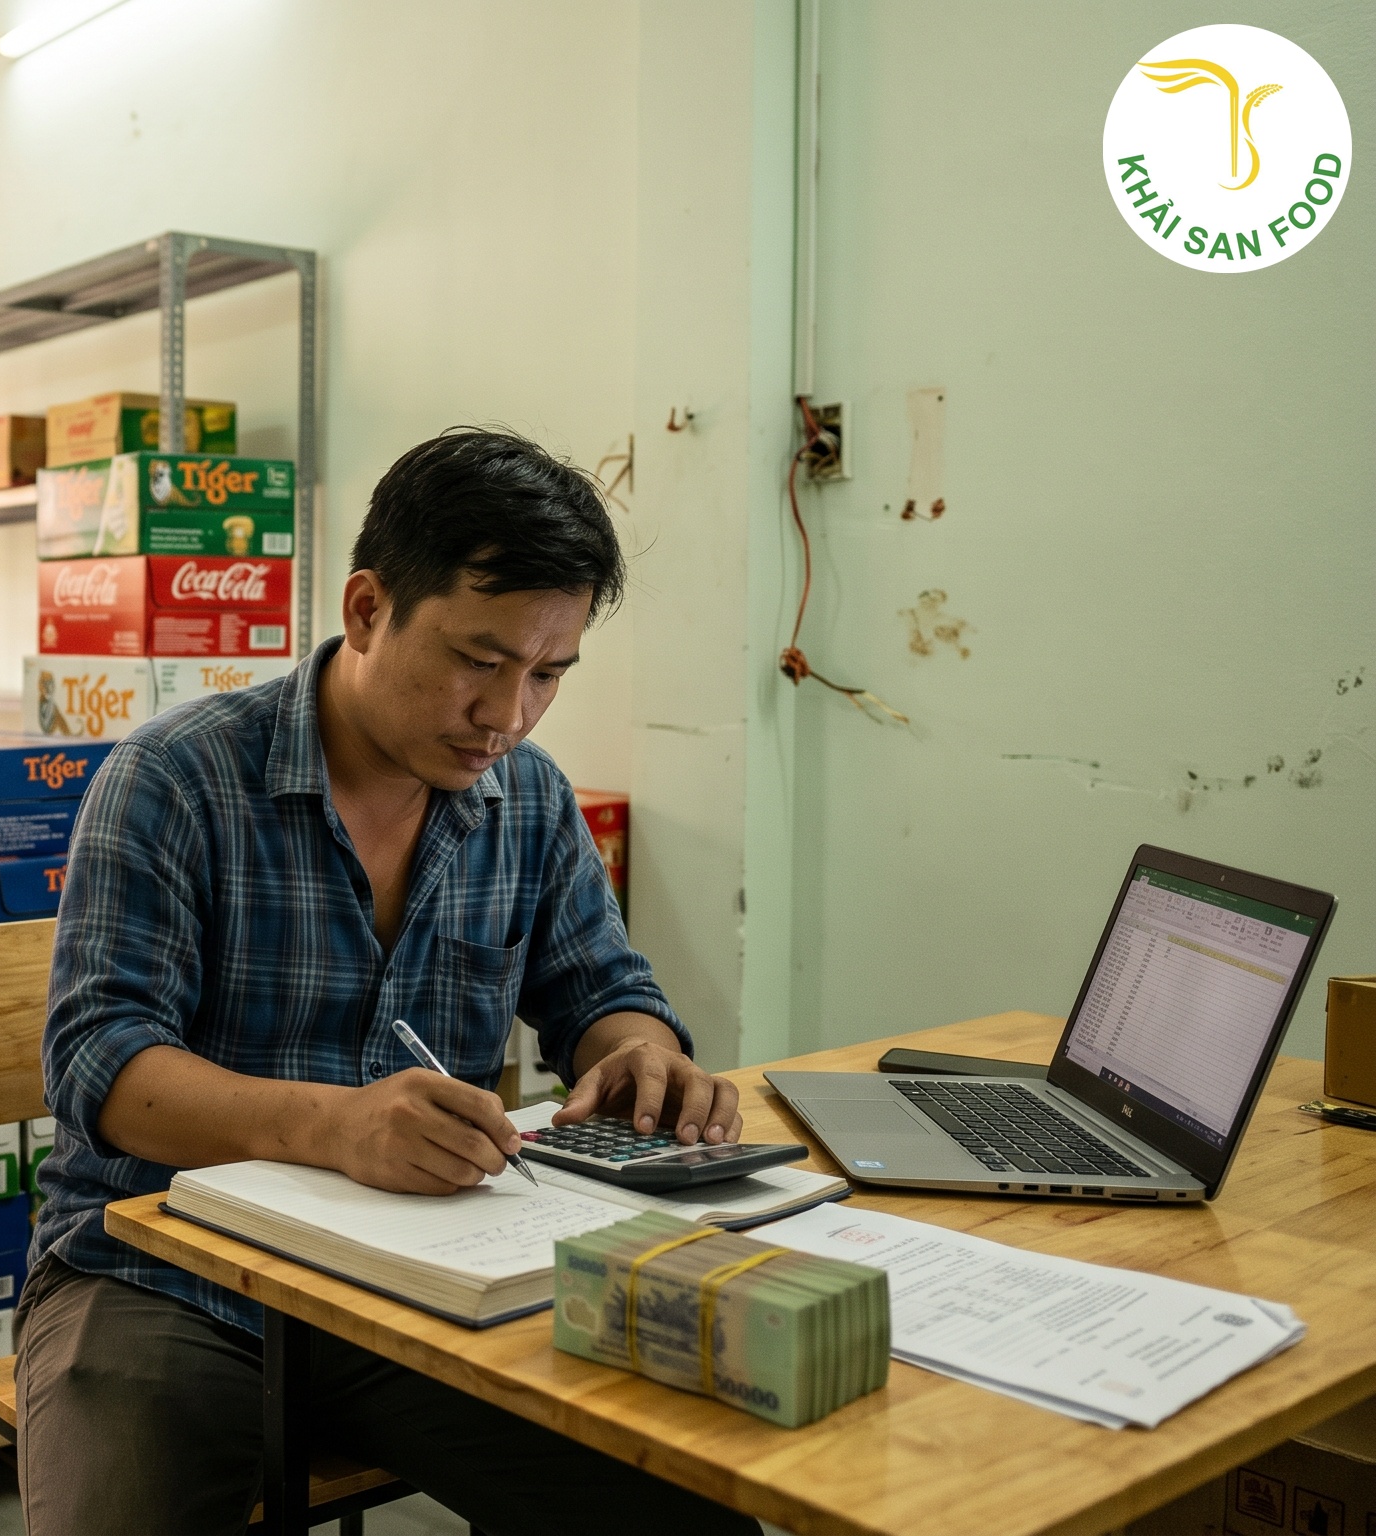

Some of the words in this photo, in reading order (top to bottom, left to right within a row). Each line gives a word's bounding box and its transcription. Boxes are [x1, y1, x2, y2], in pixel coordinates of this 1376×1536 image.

[177, 459, 259, 505] Tiger
[171, 560, 272, 600] Coca-Cola
[63, 673, 135, 737] Tiger
[24, 752, 89, 789] Tiger
